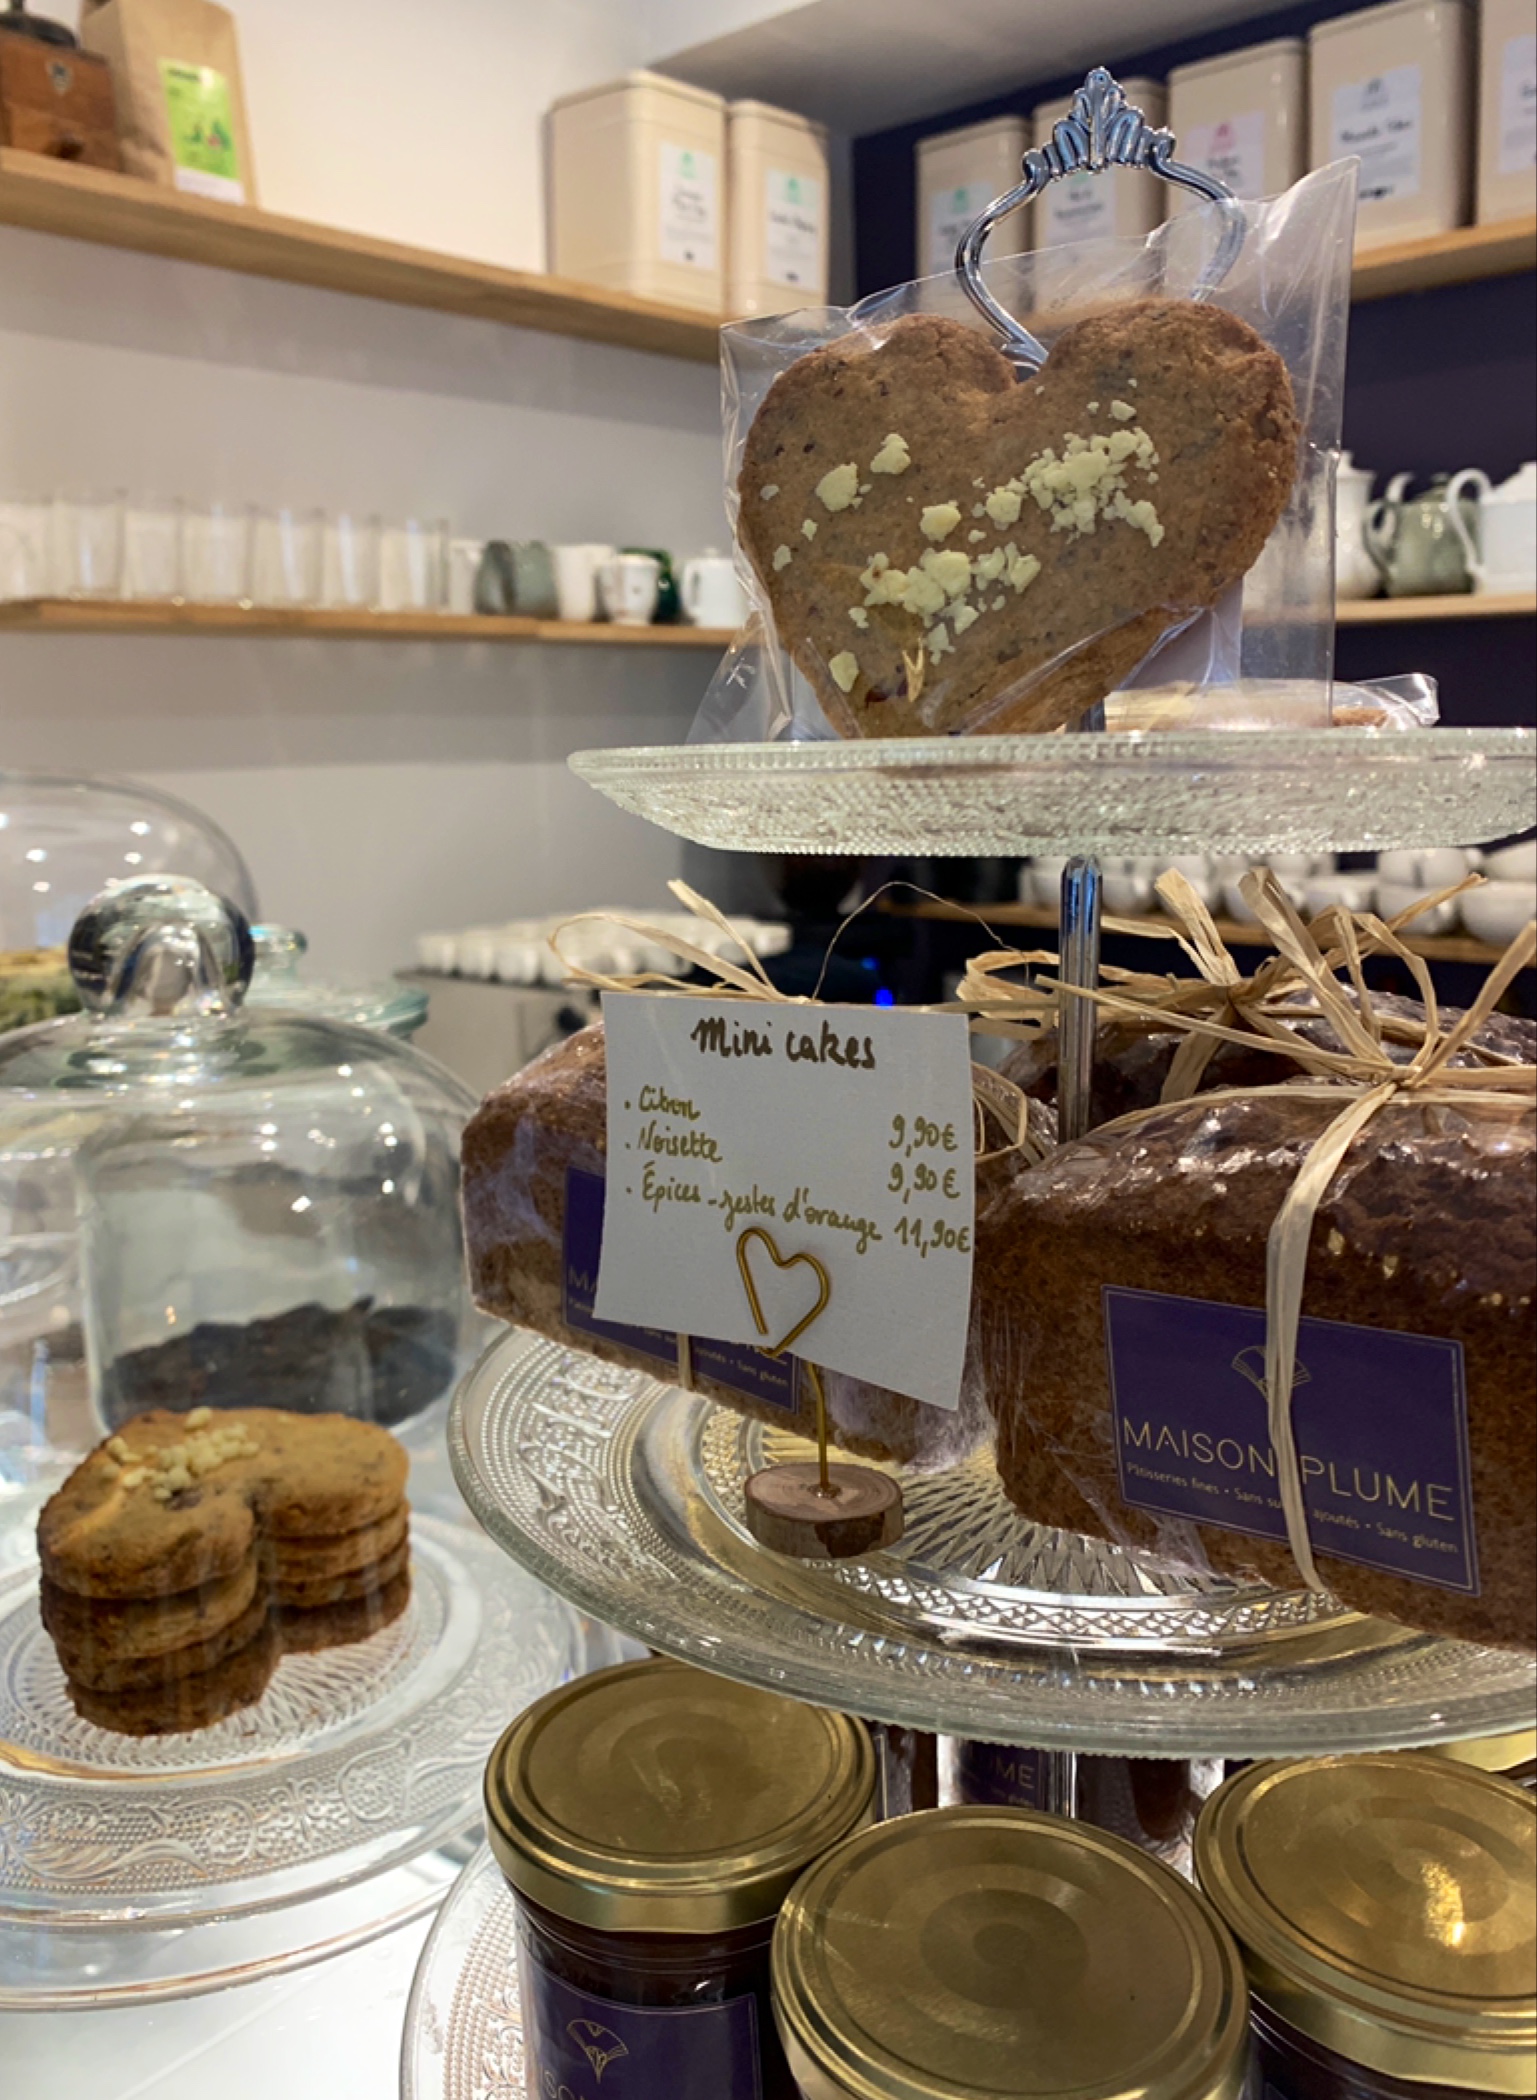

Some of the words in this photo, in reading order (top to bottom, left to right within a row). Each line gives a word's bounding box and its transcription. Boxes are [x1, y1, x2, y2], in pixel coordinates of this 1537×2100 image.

[689, 1016, 774, 1058] Mini
[786, 1020, 876, 1070] cakes
[638, 1084, 702, 1121] Citron
[888, 1113, 959, 1159] 9,90€
[637, 1119, 724, 1163] Noisette
[887, 1161, 961, 1205] 9,90€
[782, 1186, 884, 1256] d'orange
[893, 1215, 972, 1259] 11,90€
[1123, 1416, 1277, 1478] MAISON
[1299, 1454, 1456, 1522] PLUME
